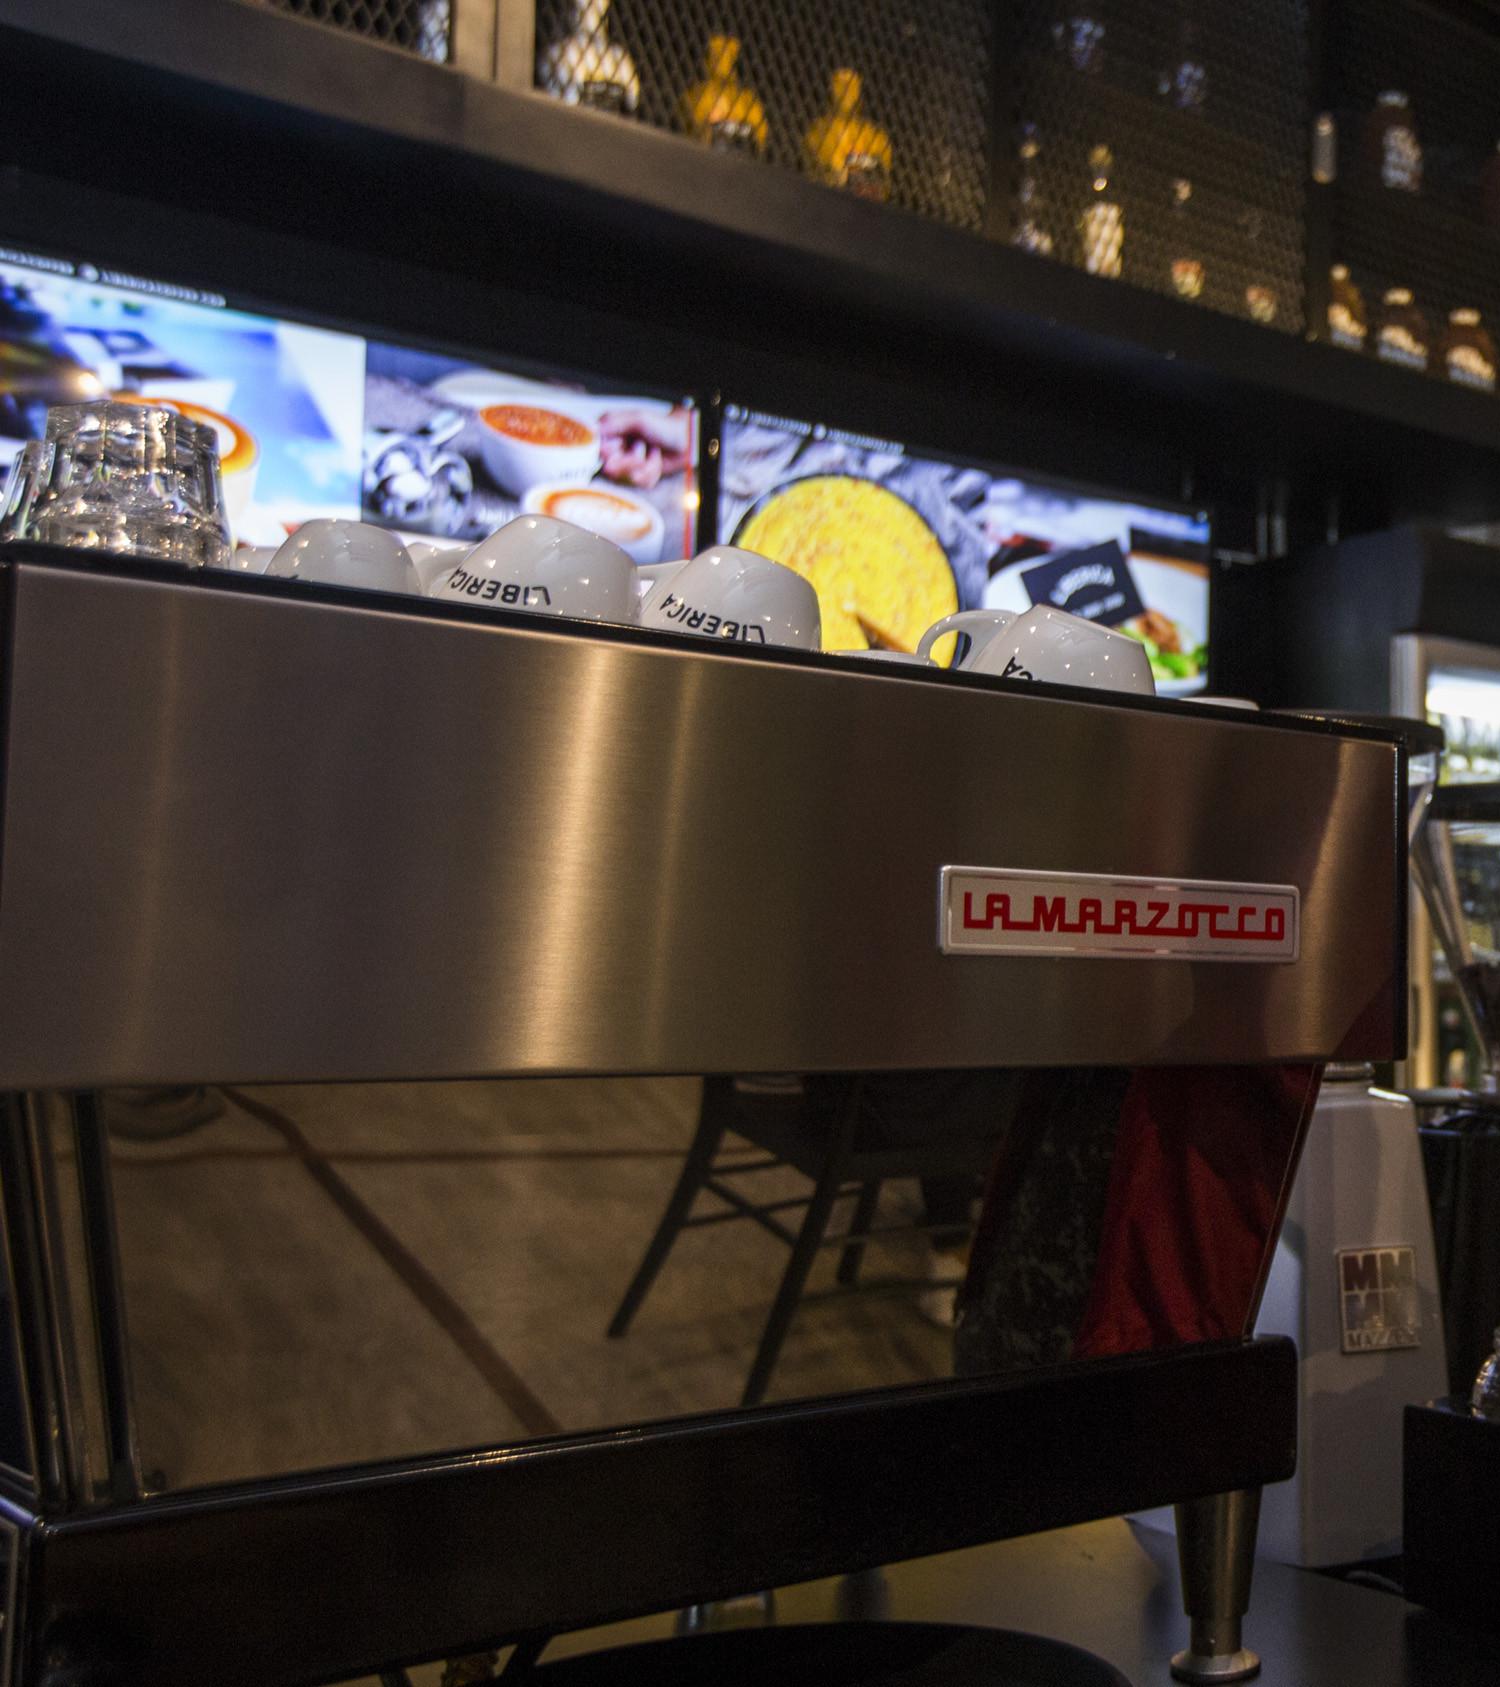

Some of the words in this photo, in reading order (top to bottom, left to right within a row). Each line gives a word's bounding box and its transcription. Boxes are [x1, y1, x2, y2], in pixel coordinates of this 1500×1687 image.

[447, 567, 551, 606] LIBERICA
[660, 593, 766, 644] LIBERICA
[963, 892, 1012, 931] LA
